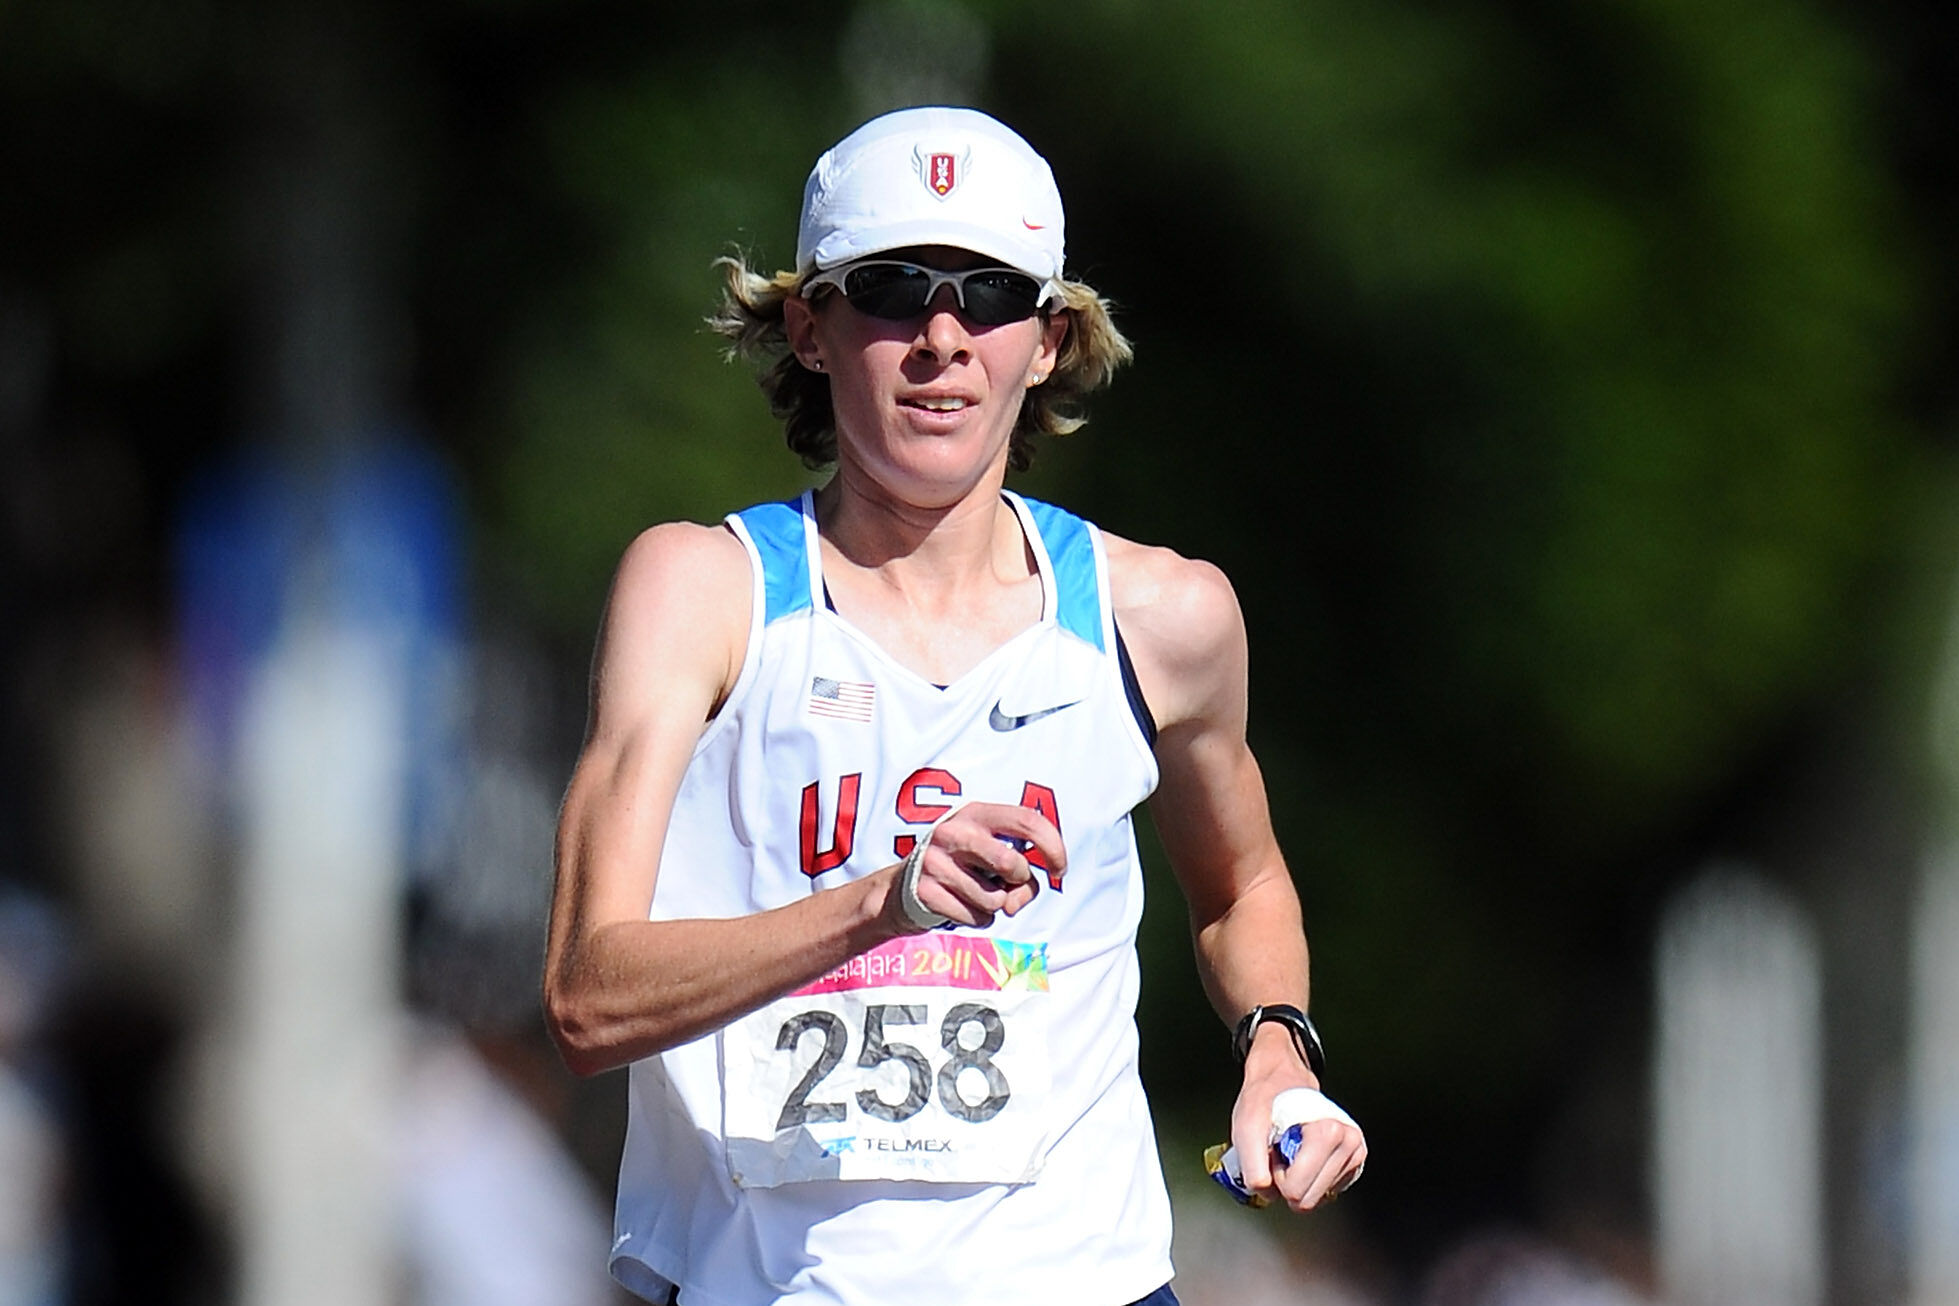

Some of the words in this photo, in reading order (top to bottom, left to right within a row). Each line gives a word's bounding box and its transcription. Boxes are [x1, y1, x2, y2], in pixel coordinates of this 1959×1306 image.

[911, 948, 972, 981] 2011
[775, 1002, 1011, 1132] 258
[863, 1138, 952, 1152] TELMEX
